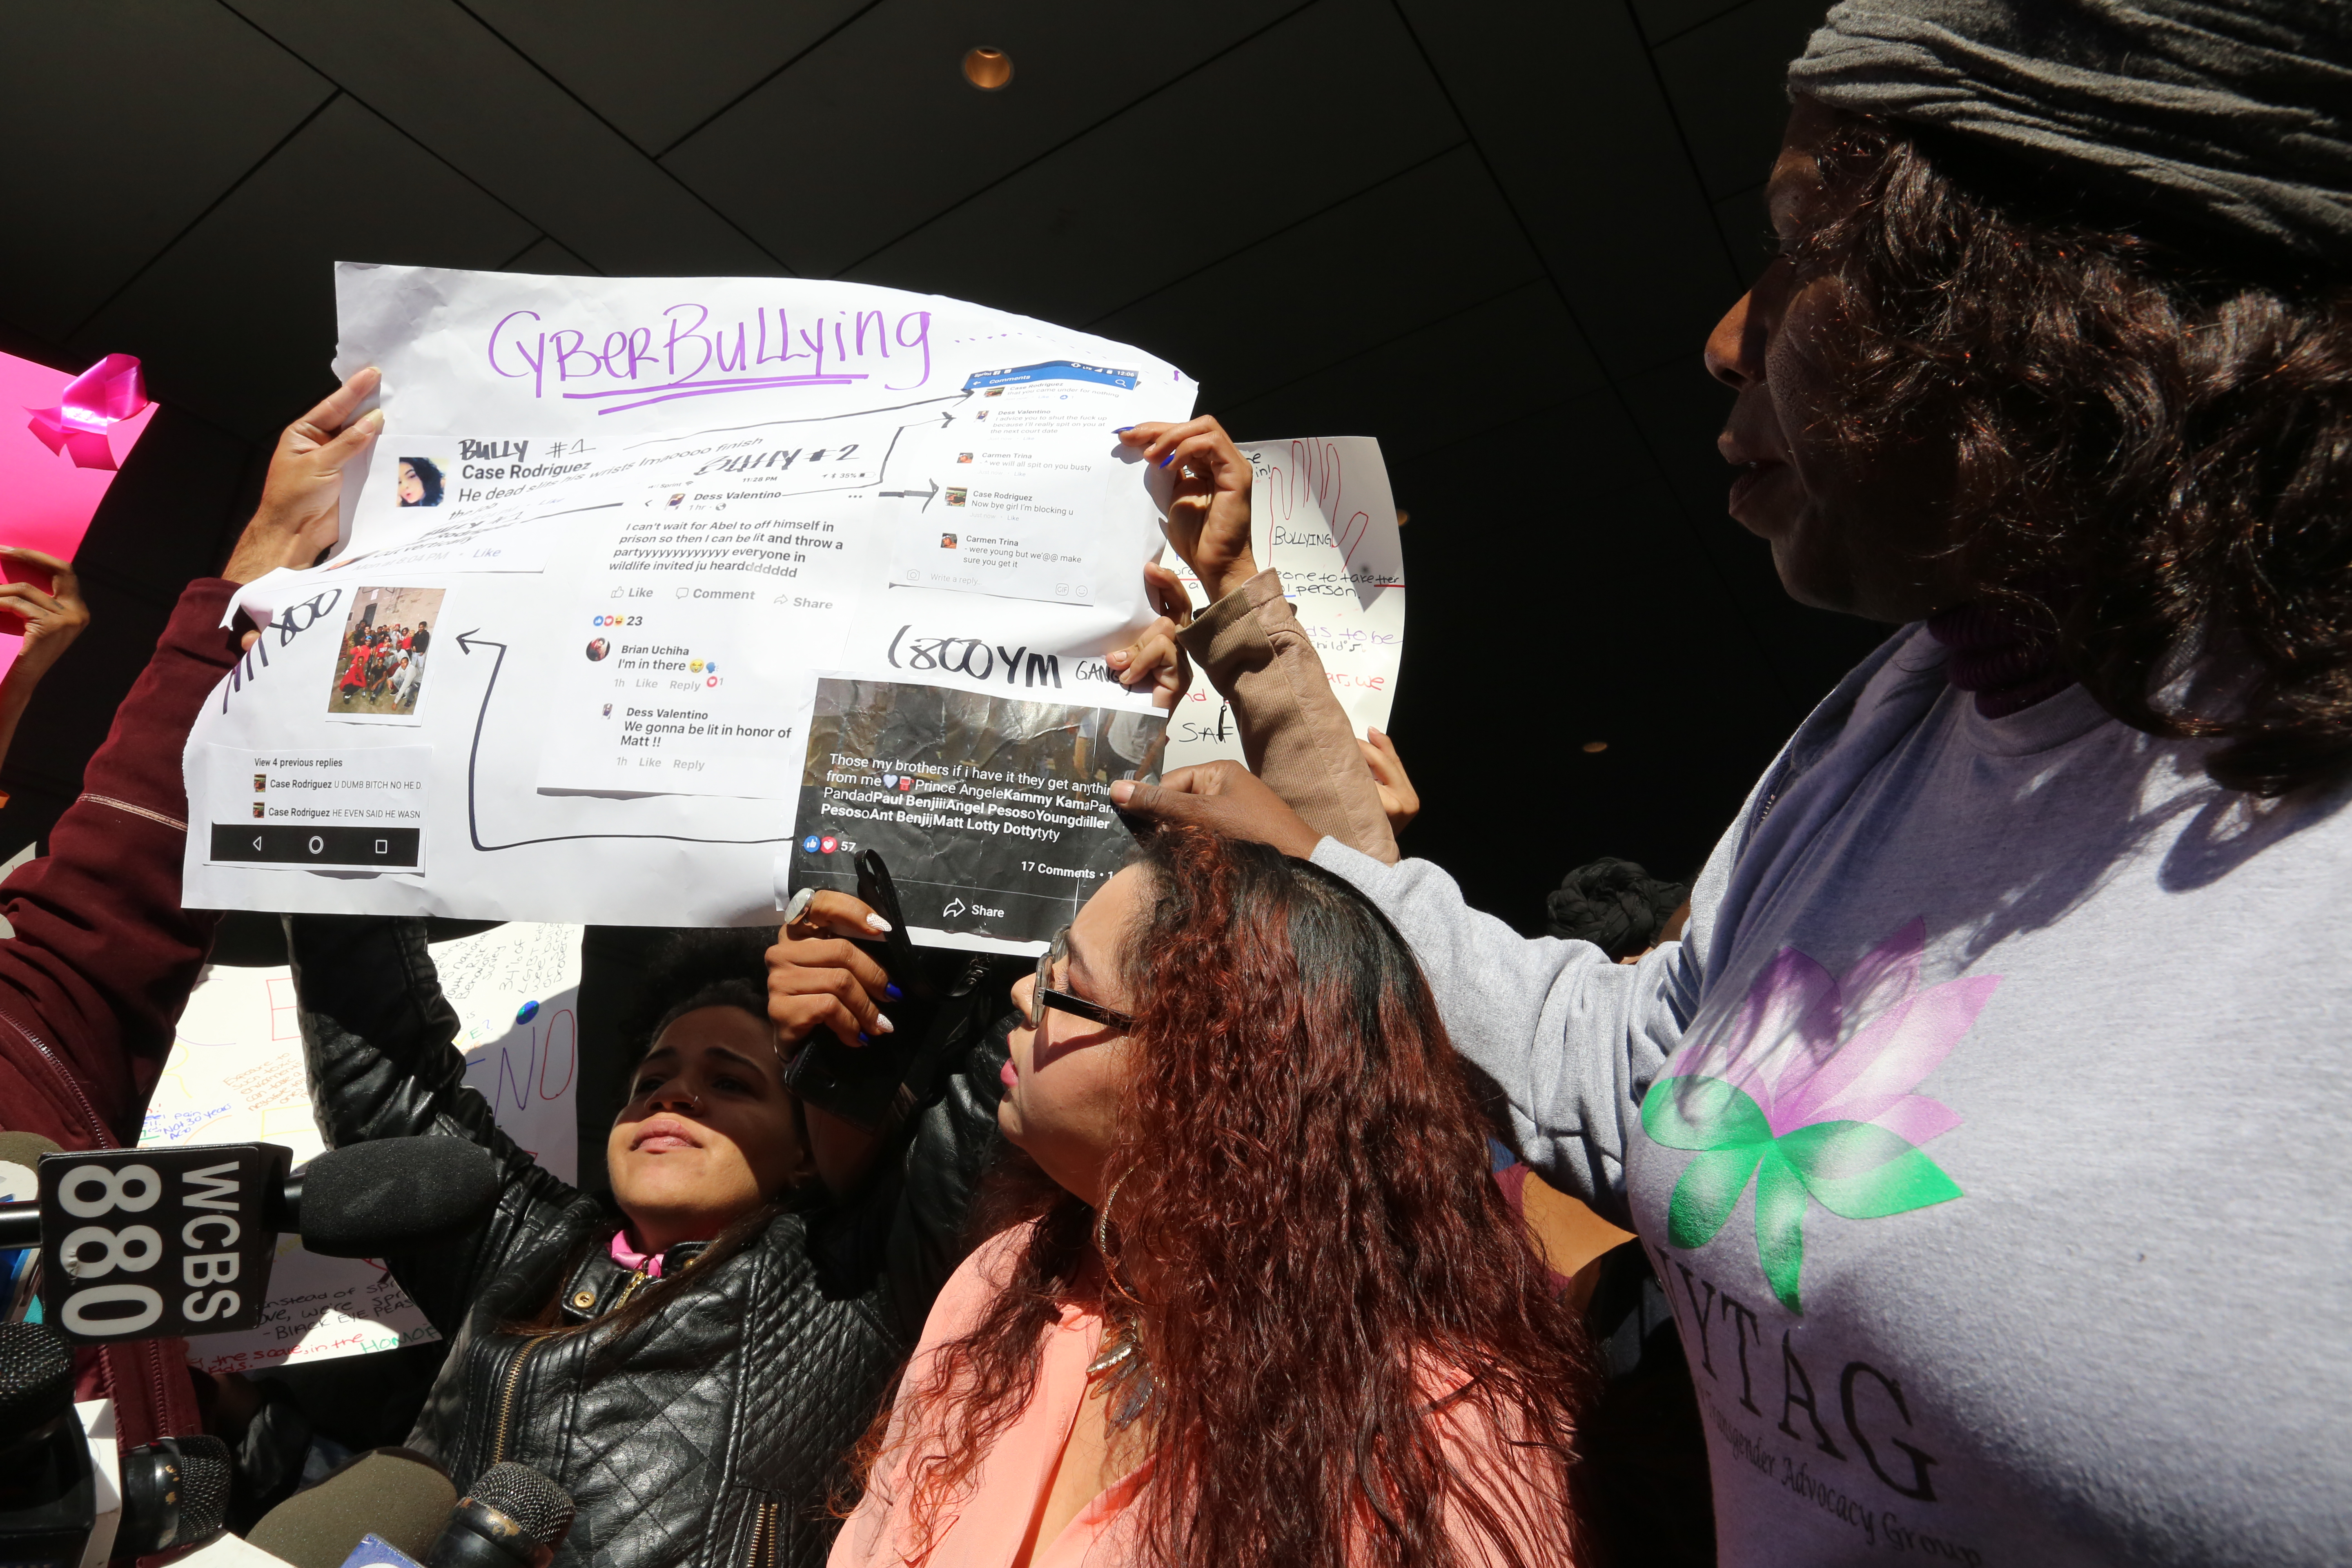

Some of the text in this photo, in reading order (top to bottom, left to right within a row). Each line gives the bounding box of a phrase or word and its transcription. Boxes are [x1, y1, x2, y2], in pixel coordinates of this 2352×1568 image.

[989, 374, 1031, 384] Comments
[546, 439, 596, 459] #1
[459, 438, 764, 502] He dead his wrists finish
[462, 462, 591, 480] Case Rodriguez
[1070, 463, 1091, 472] busty
[694, 491, 782, 501] Dess Valentino
[994, 492, 1033, 502] Rodriguez
[991, 501, 1004, 510] bye
[1006, 503, 1019, 511] girl
[1034, 505, 1067, 516] blocking
[663, 522, 688, 530] wait
[690, 521, 708, 530] for
[709, 521, 738, 530] Abel
[754, 520, 772, 529] off
[773, 519, 821, 531] himself
[822, 521, 834, 532] in
[619, 535, 657, 545] prison
[676, 534, 702, 543] then
[735, 534, 751, 543] be
[753, 533, 765, 541] lit
[767, 534, 792, 544] and
[795, 535, 833, 549] throw
[966, 535, 1018, 546] Carmen Trina
[1272, 526, 1333, 547] BULLYING
[732, 548, 791, 561] everyone
[794, 551, 806, 563] in
[989, 549, 1013, 558] young
[1015, 550, 1029, 558] but
[609, 561, 651, 570] wildlife
[653, 561, 694, 570] invited
[694, 561, 707, 572] ju
[931, 573, 951, 582] Write
[1319, 573, 1399, 584] to take their
[628, 587, 833, 609] Like Comment Share
[626, 616, 643, 626] 23
[621, 645, 689, 656] Brian Uchiha
[618, 659, 686, 671] I'm in there
[614, 678, 701, 692] 1h Like Reply
[626, 707, 708, 720] Dess Valentino
[625, 721, 792, 738] We gonna be lit in honor of
[620, 735, 661, 747] Matt !!
[254, 757, 343, 769] View 4 previous replies
[830, 753, 1069, 793] Those my brothers if have it they get
[270, 779, 414, 791] Case Rodriguez DUMB BITCH NO HE
[826, 770, 858, 784] from
[861, 775, 882, 787] me
[915, 779, 956, 796] Prince
[268, 807, 421, 819] Case Rodriguez HE EVEN SAID HE WASN
[967, 818, 1000, 835] Lotty
[840, 841, 856, 853] 57
[1021, 860, 1096, 880] 17 Comments
[971, 904, 1004, 918] Share
[181, 1161, 241, 1323] WCBS
[58, 1164, 164, 1336] 880
